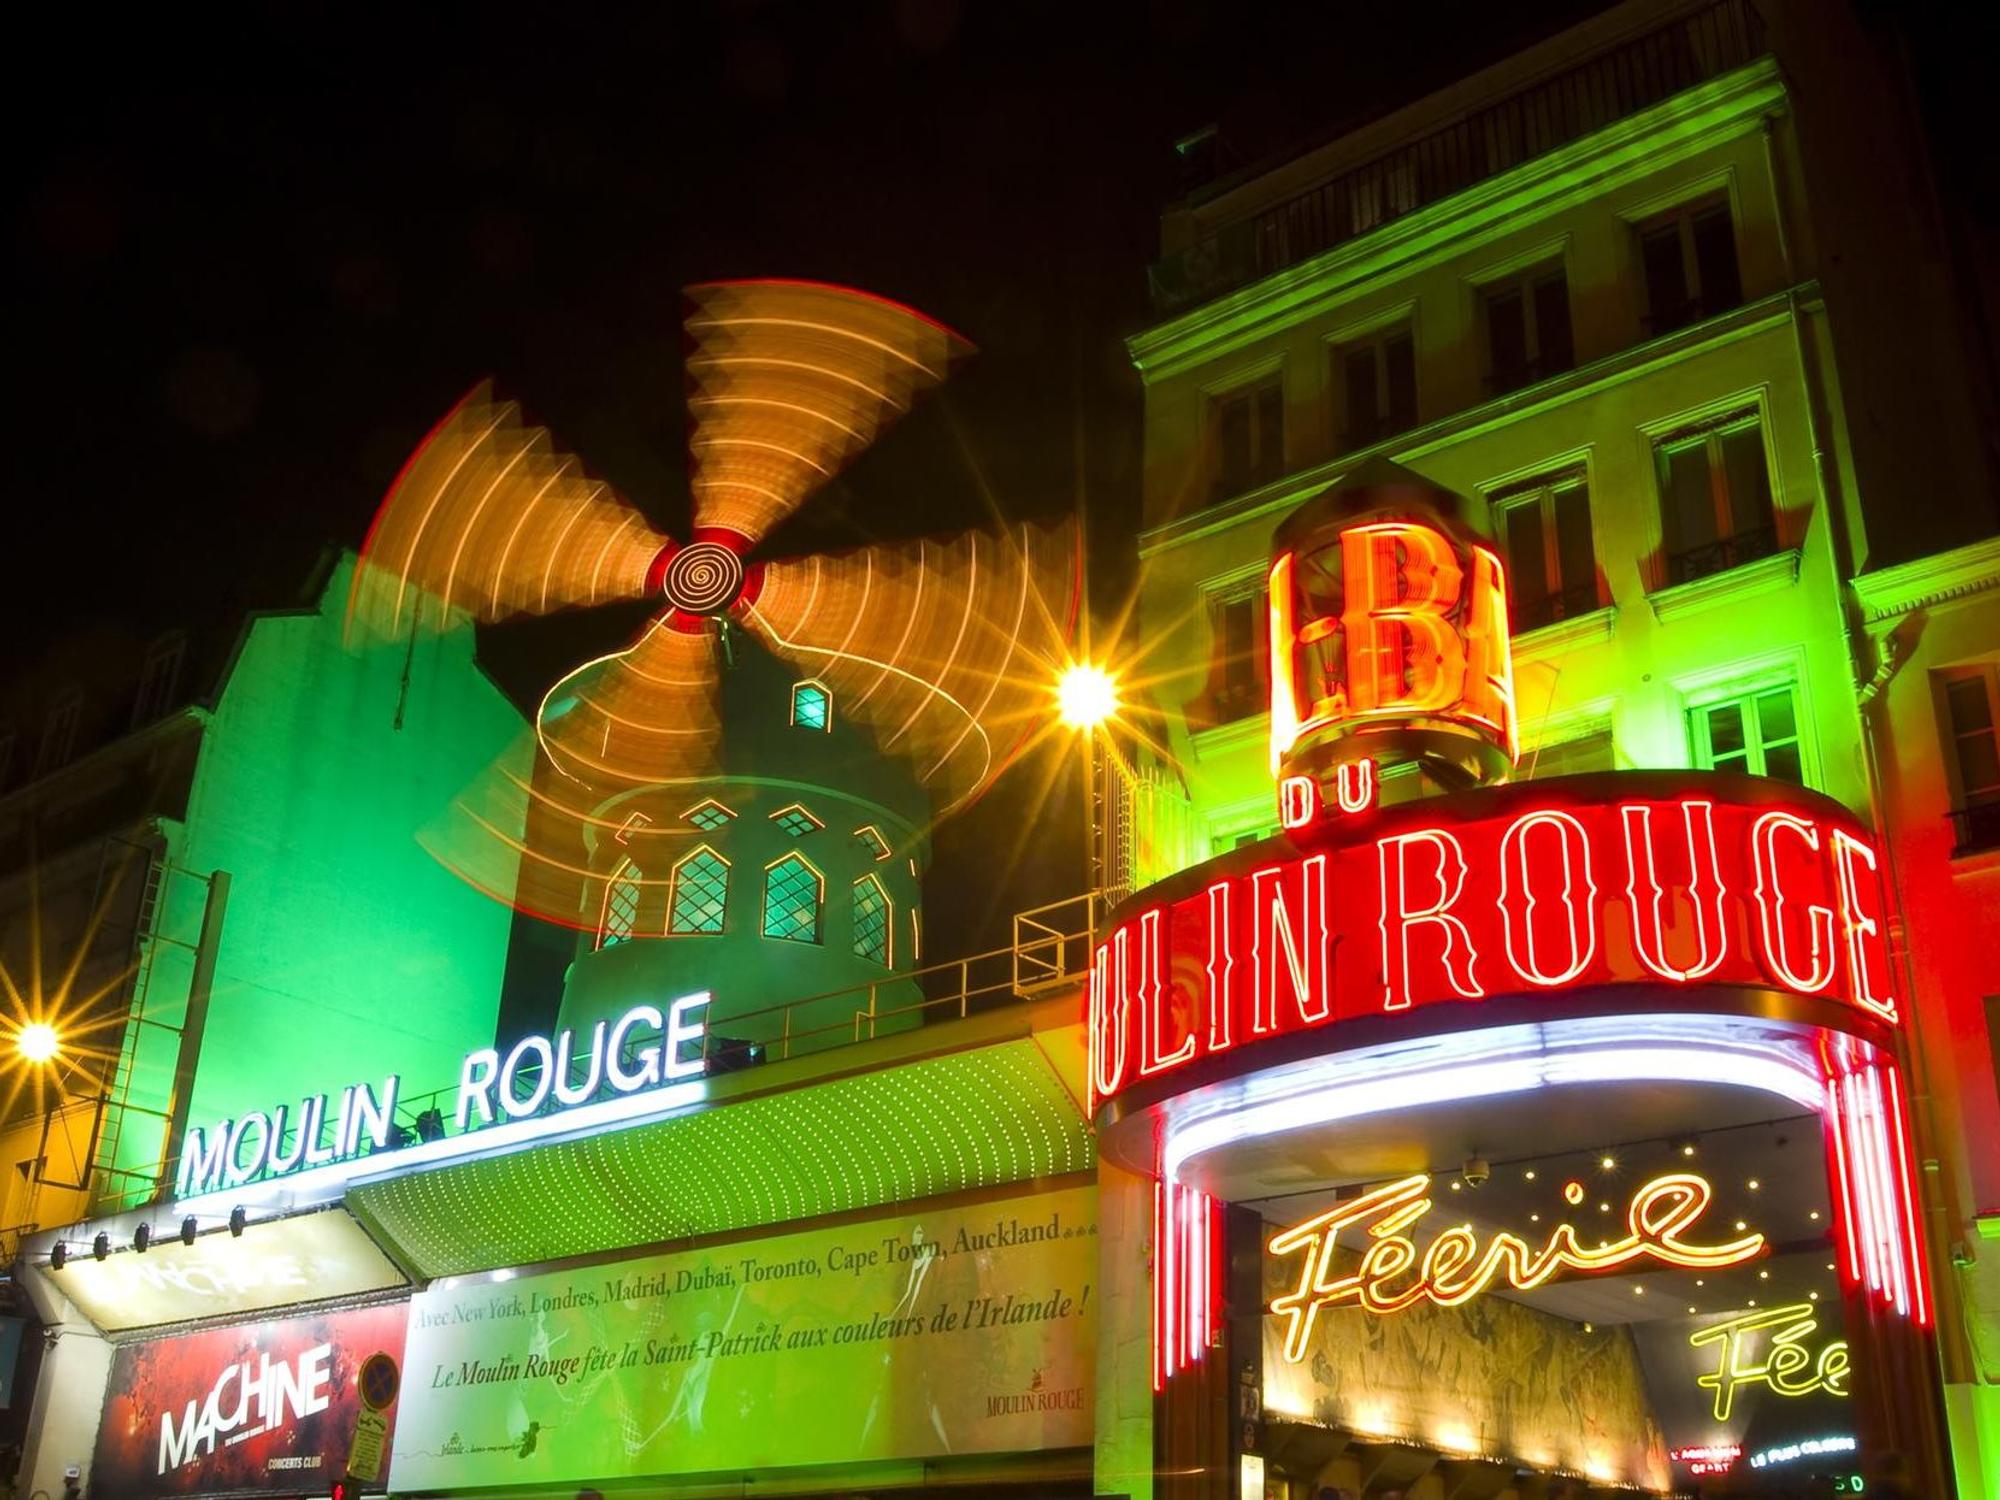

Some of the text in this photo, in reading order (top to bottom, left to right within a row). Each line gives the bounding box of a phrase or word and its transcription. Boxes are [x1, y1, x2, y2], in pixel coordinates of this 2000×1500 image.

[1281, 758, 1376, 829] DU
[1088, 801, 1899, 1118] ULIN ROUGE
[174, 990, 712, 1197] MOULIN ROUGE
[415, 1309, 450, 1329] Avec
[452, 1302, 485, 1325] New
[487, 1294, 527, 1320] York,
[530, 1286, 599, 1314] Londres,
[604, 1272, 671, 1302] Madrid,
[675, 1264, 736, 1294] Dubaï,
[740, 1258, 822, 1283] Toronto,
[827, 1246, 878, 1276] Cape
[882, 1237, 948, 1264] Town,
[1269, 1173, 1765, 1363] Féerie
[431, 1363, 453, 1389] Le
[456, 1356, 520, 1386] Moulin
[523, 1353, 580, 1385] Rouge
[576, 1344, 617, 1383] fête
[619, 1342, 639, 1369] la
[643, 1324, 782, 1366] Saint-Patrick
[786, 1327, 828, 1350] aux
[832, 1311, 925, 1345] couleurs
[930, 1303, 957, 1334] de
[986, 1386, 1085, 1418] MOULIN ROUGE
[157, 1342, 332, 1476] MACHINE
